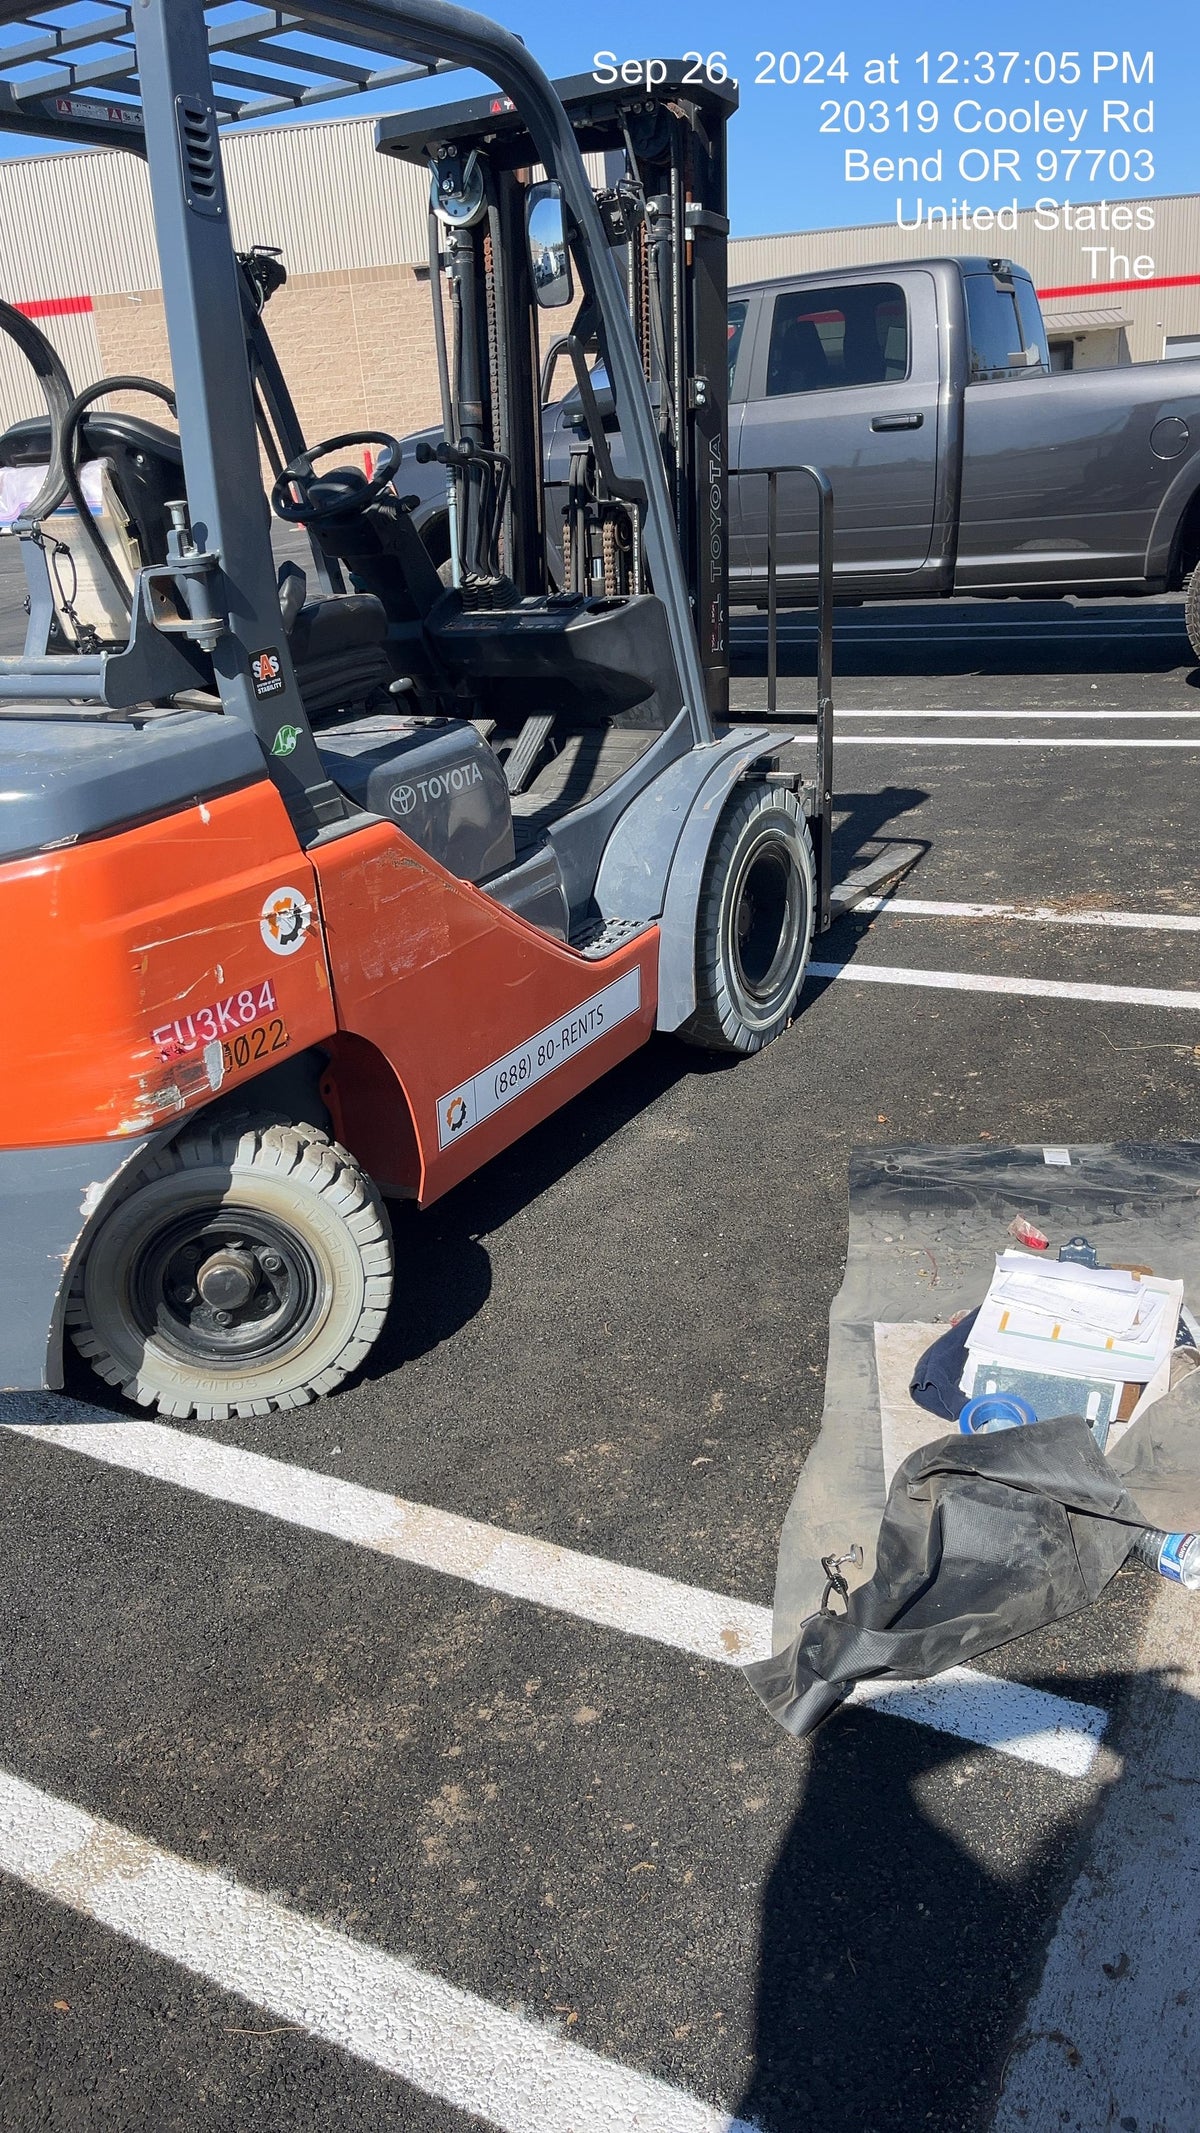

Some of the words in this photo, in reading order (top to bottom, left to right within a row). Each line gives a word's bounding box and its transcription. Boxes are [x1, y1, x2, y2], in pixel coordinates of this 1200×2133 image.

[709, 433, 722, 583] TOYOTA
[252, 654, 280, 681] SAS
[257, 681, 282, 694] STABILITY
[416, 761, 484, 804] TOYOTA
[493, 1053, 533, 1100] (888)
[537, 1003, 605, 1067] 80-RENTS
[167, 1368, 259, 1393] SOLIDEAL
